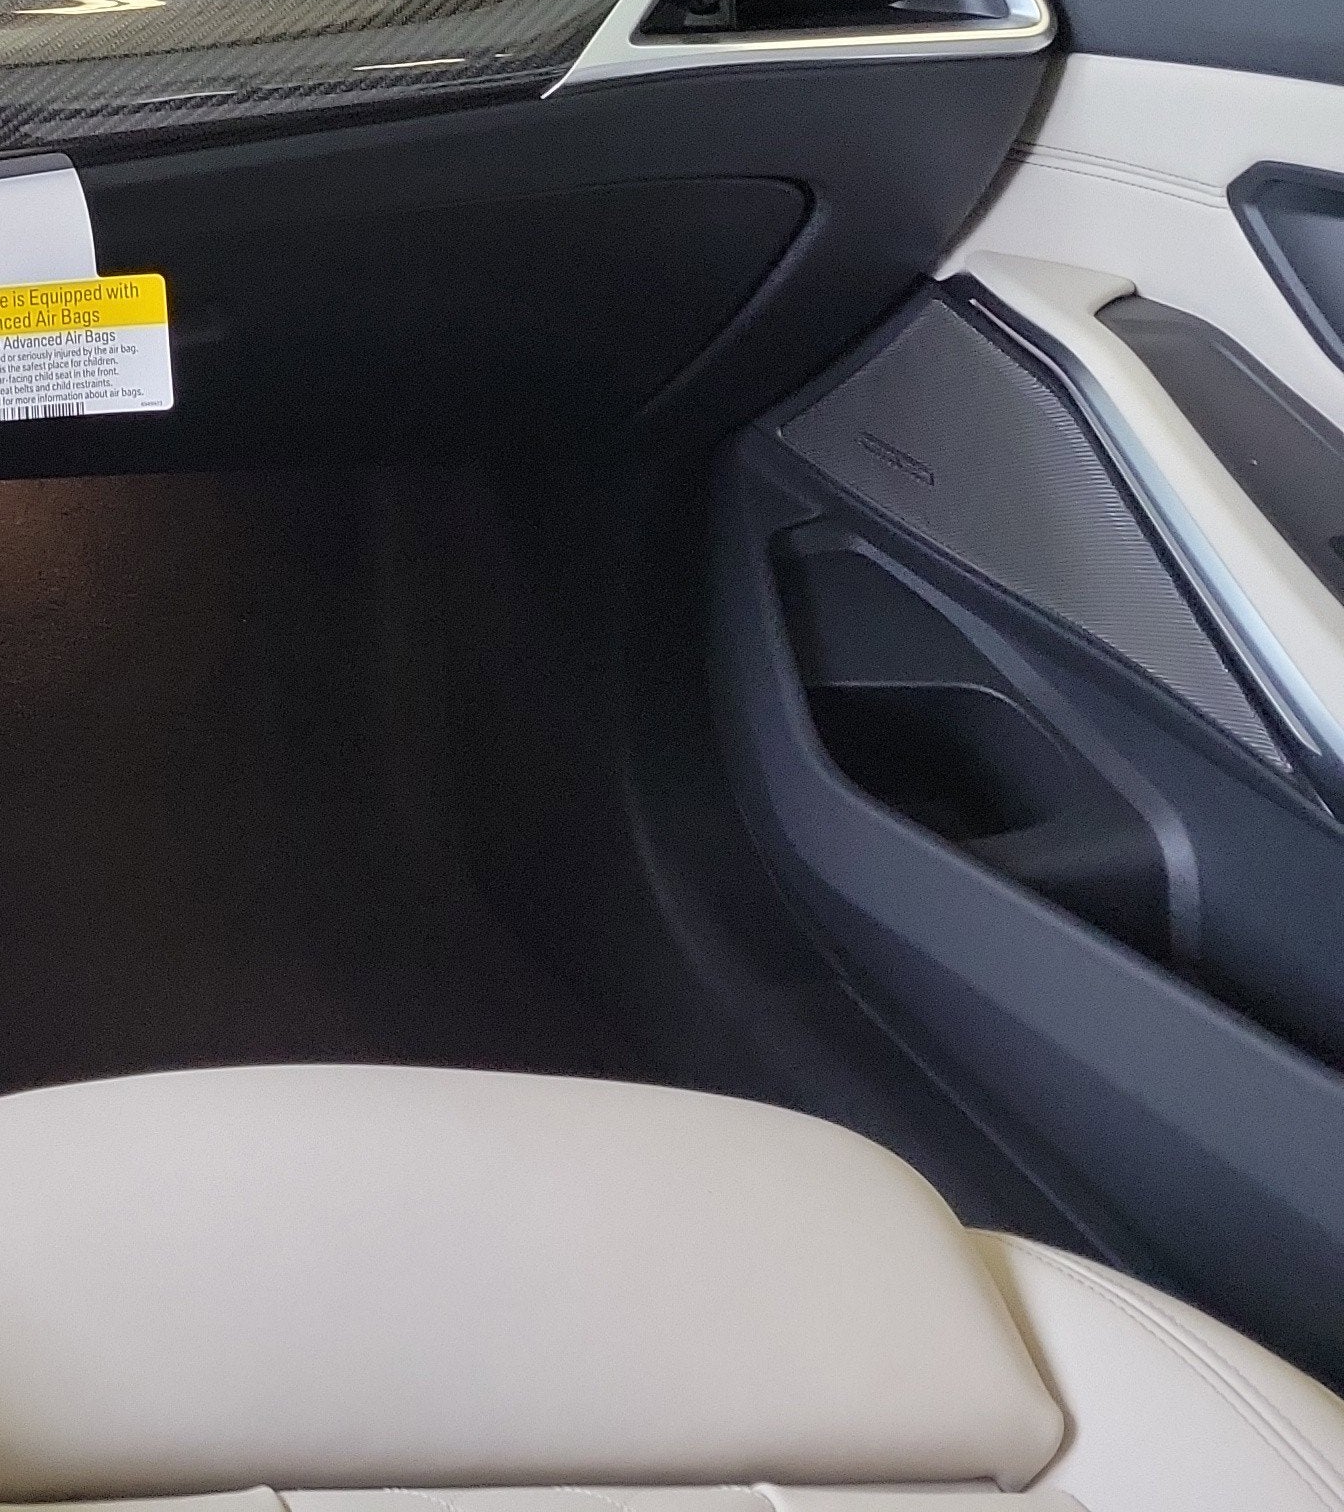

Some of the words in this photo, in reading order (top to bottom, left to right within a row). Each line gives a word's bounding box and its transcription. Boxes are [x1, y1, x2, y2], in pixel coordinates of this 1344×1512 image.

[13, 290, 25, 308] is
[30, 284, 102, 310] Equipped
[106, 281, 139, 301] with
[36, 309, 57, 328] Air
[61, 306, 100, 329] Bags
[4, 332, 62, 351] Advanced
[65, 330, 82, 346] Air
[85, 327, 116, 347] Bags
[8, 355, 16, 363] or
[17, 350, 52, 364] seriously
[54, 347, 81, 361] injured
[82, 346, 92, 359] by
[94, 345, 107, 356] the
[109, 344, 118, 354] air
[120, 343, 138, 356] bag.
[0, 364, 6, 374] is
[8, 363, 21, 373] the
[22, 361, 46, 372] safest
[47, 359, 69, 372] place
[71, 358, 81, 368] for
[83, 355, 118, 367] children.
[34, 371, 54, 382] child
[55, 370, 72, 380] seat
[73, 369, 81, 379] in
[82, 368, 97, 378] the
[97, 366, 119, 377] front.
[14, 384, 34, 394] belts
[35, 382, 50, 393] and
[52, 381, 71, 391] child
[72, 377, 113, 390] restraints.
[2, 397, 13, 407] for
[15, 397, 36, 406] more
[37, 391, 83, 404] information
[84, 389, 107, 400] about
[109, 388, 120, 398] air
[121, 386, 144, 400] bags.
